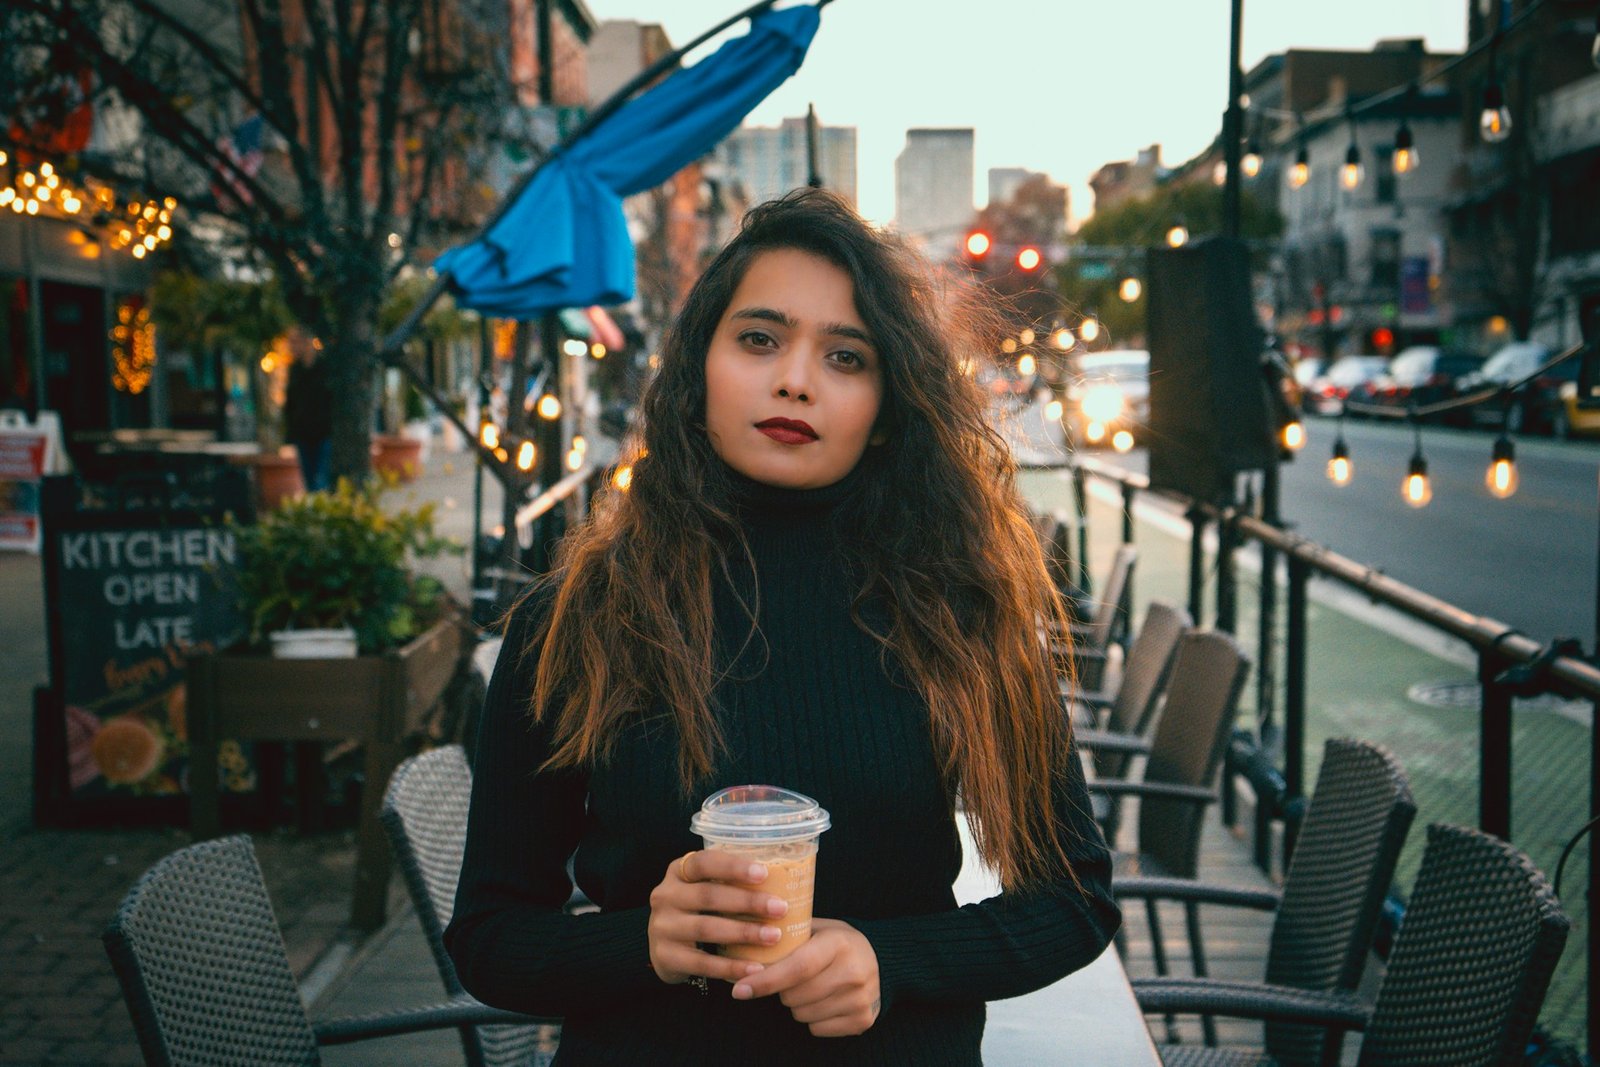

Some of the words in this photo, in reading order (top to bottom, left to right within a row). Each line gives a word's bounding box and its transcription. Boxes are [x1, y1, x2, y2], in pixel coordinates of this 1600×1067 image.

[62, 530, 235, 569] KITCHEN
[103, 571, 199, 605] OPEN
[114, 616, 193, 648] LATE
